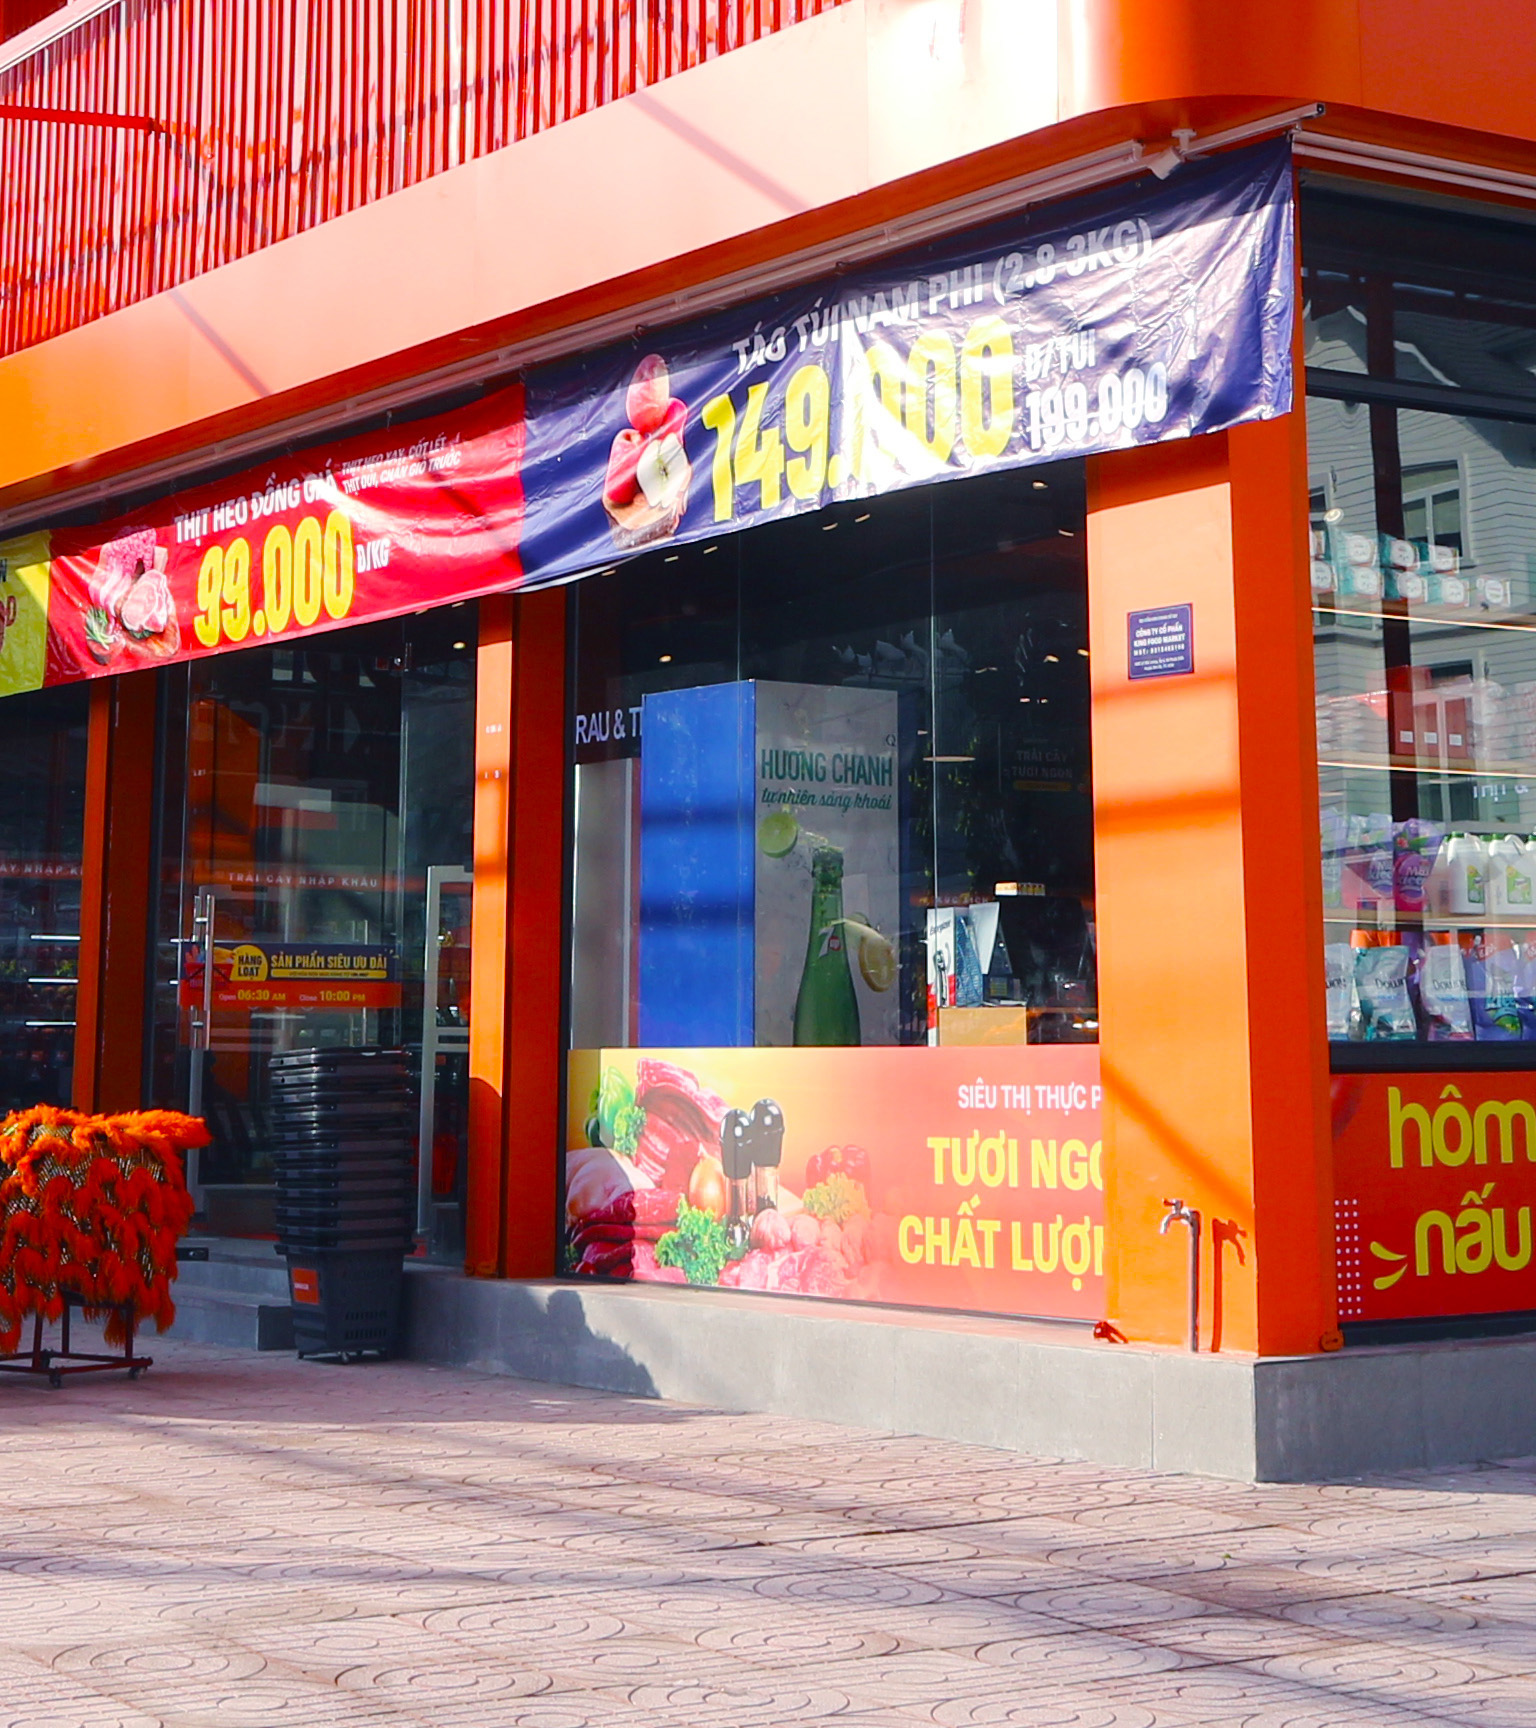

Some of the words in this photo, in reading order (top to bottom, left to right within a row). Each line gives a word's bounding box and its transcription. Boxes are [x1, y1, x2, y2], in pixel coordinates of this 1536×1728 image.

[926, 262, 984, 316] PHI
[1026, 361, 1168, 450] 199.000
[174, 507, 212, 547] THỊT
[213, 495, 249, 533] HEO
[250, 472, 302, 521] ĐỒNG
[193, 509, 355, 648] 99.000
[575, 710, 610, 745] RAU
[613, 708, 626, 740] &
[760, 748, 826, 783] HƯƠNG
[831, 752, 894, 787] CHANH
[237, 951, 263, 966] HÀNG
[326, 952, 351, 970] SIÊU
[237, 988, 270, 1001] 06:30
[271, 992, 287, 1002] AM
[319, 989, 351, 1002] 10:00
[352, 993, 366, 1002] PM
[957, 1076, 997, 1110] SIÊU
[1000, 1084, 1032, 1116] THỊ
[1034, 1081, 1087, 1116] THỰC
[926, 1128, 1019, 1188] TƯƠI
[898, 1193, 1002, 1269] CHẤT
[1415, 1181, 1535, 1276] nấu
